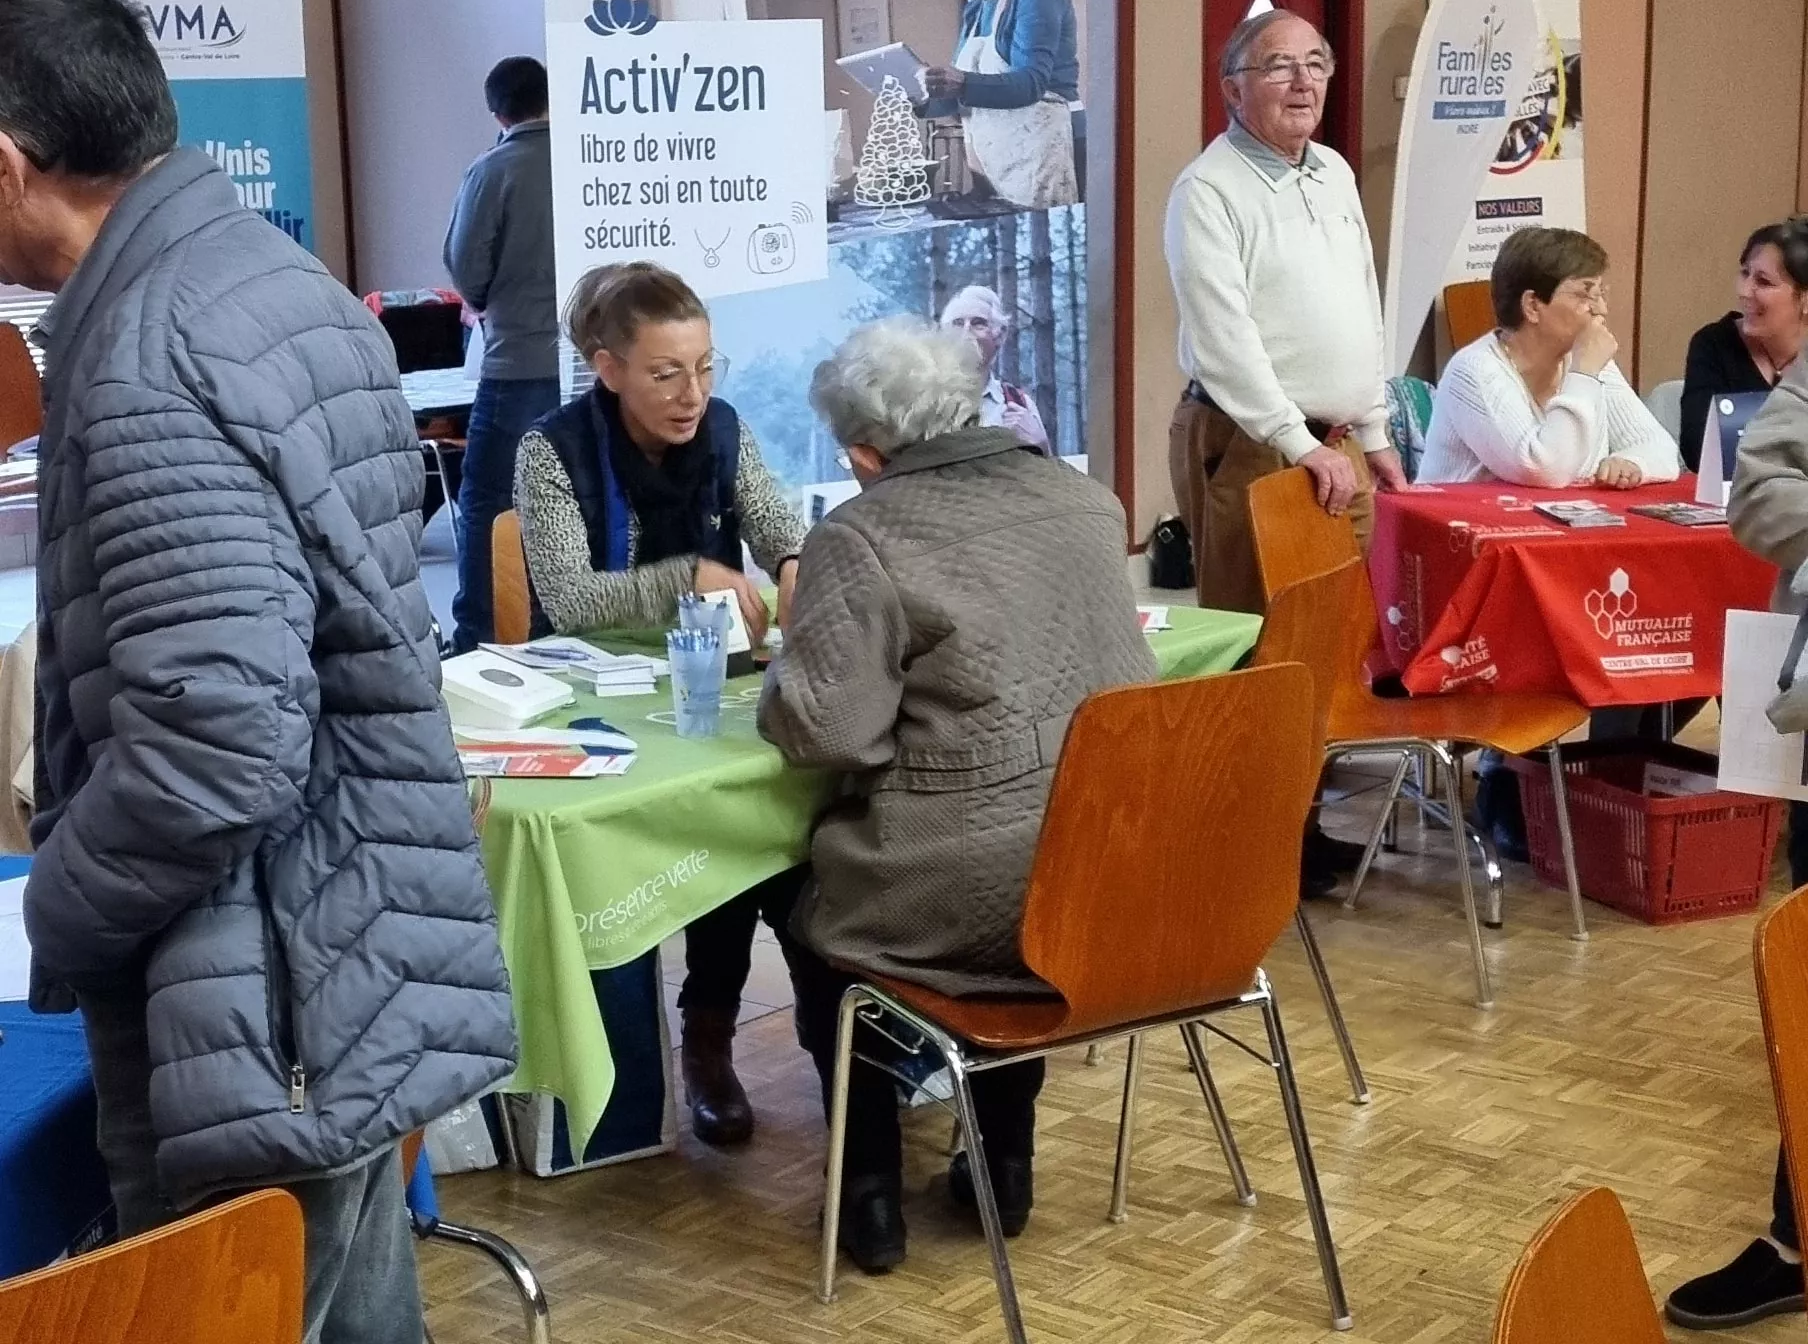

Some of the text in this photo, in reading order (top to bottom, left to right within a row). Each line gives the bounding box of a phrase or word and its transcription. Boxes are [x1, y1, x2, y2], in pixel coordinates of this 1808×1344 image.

[580, 52, 766, 115] Activ'zen
[580, 131, 716, 163] libre de vivre
[583, 174, 767, 206] chez soi en toute
[1479, 200, 1541, 215] NOS VALEURS
[584, 216, 676, 249] sécurité.
[1615, 612, 1693, 632] MUTUALITÉ
[1617, 630, 1692, 648] FRANÇAISE
